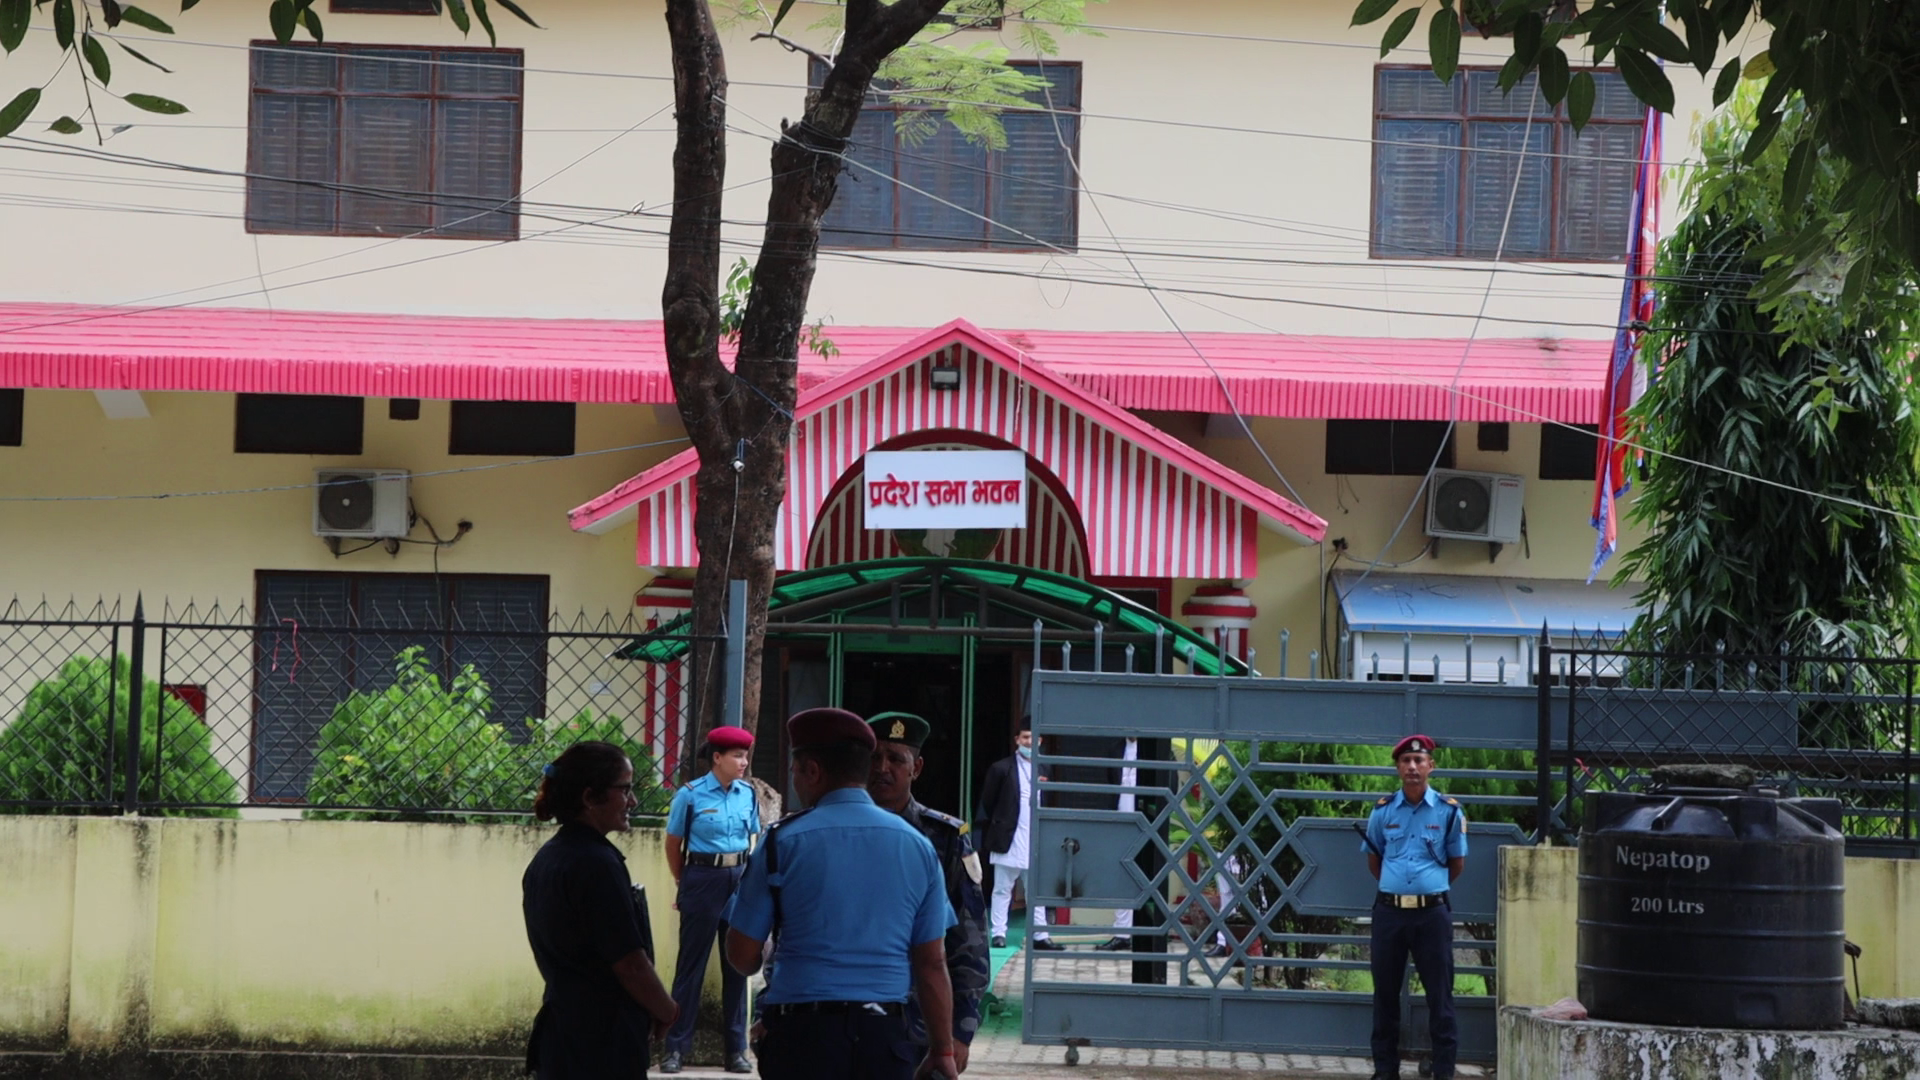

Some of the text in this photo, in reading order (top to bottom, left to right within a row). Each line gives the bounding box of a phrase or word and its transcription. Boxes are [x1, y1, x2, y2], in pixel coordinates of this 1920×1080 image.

[868, 473, 1021, 507] प्रदेश सभा भवन
[1616, 845, 1710, 872] Nepatop
[1631, 897, 1704, 914] 200 Ltrs
